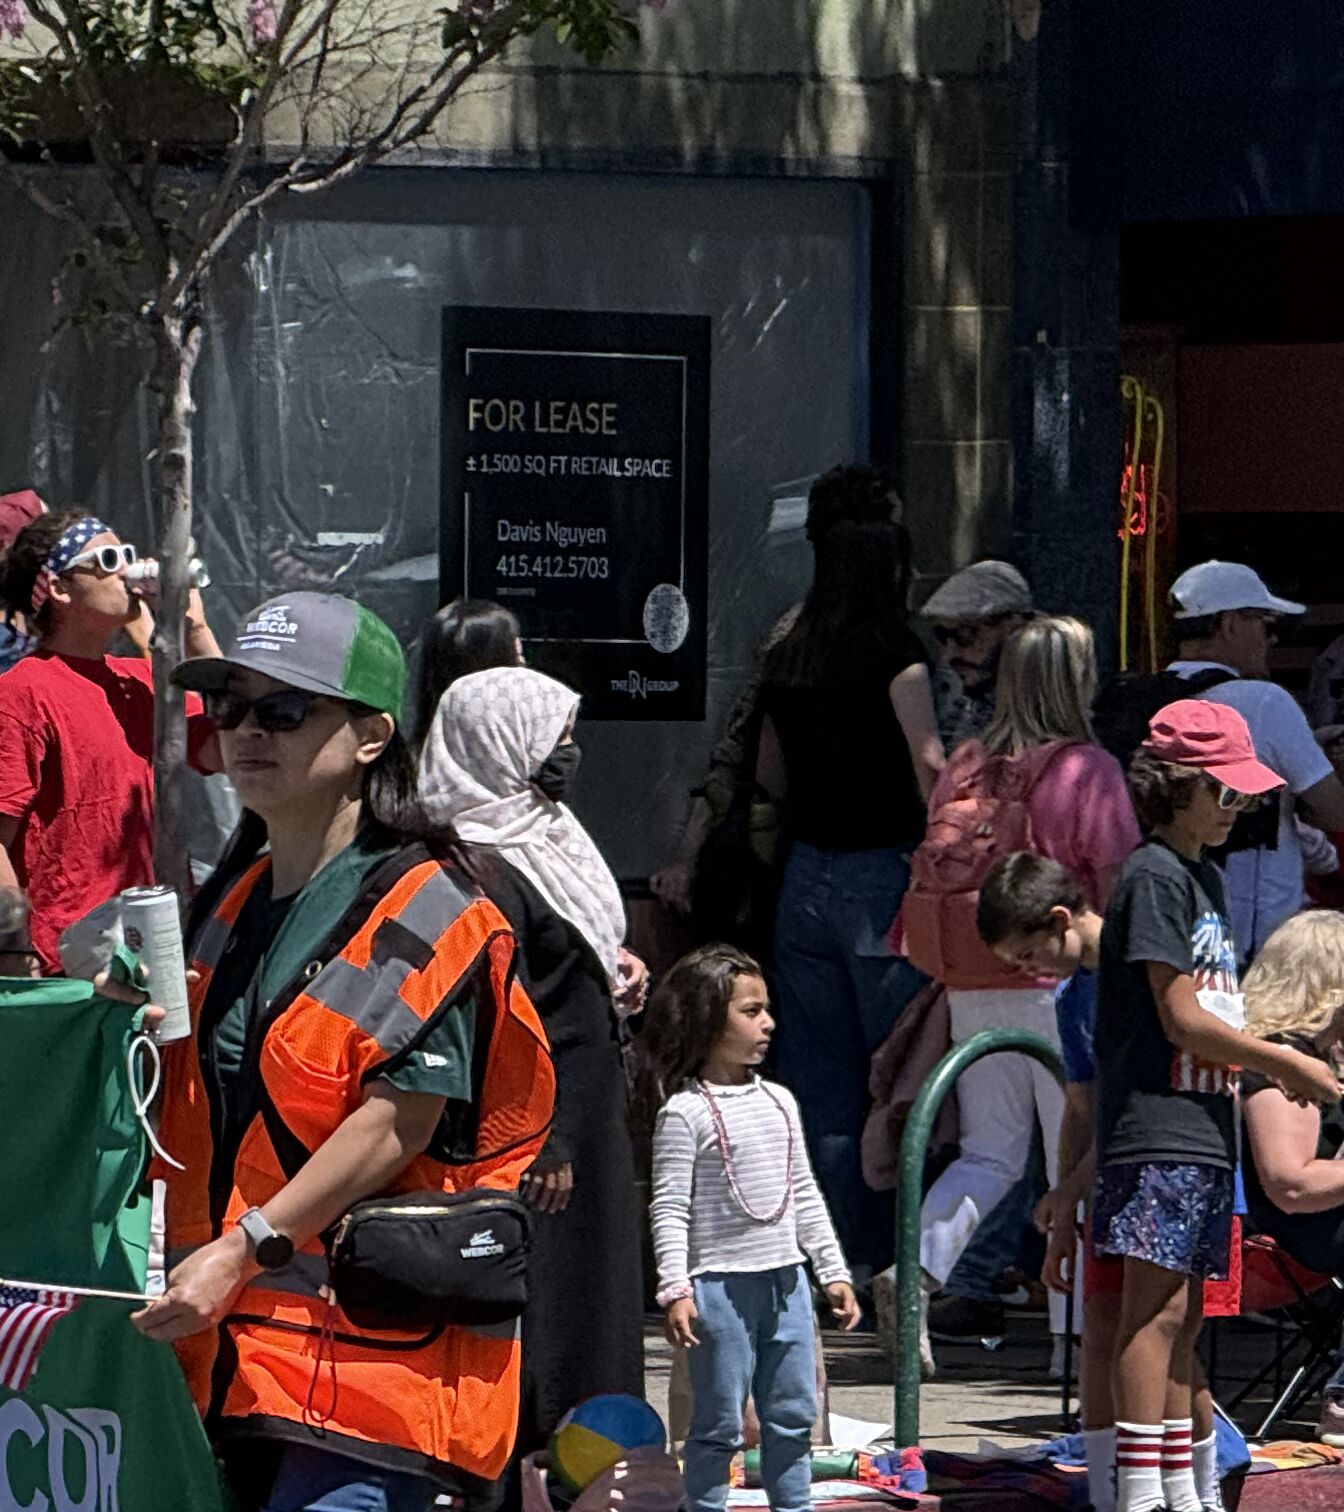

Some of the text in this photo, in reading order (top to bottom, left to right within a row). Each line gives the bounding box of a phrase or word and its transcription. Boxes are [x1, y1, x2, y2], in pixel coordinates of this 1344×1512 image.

[468, 398, 618, 435] FOR LEASE
[523, 455, 546, 477] SQ
[549, 456, 568, 474] FT
[571, 457, 621, 477] RETAIL
[623, 457, 673, 478] SPACE
[497, 519, 607, 548] Davis Nguyen
[496, 554, 609, 579] 415.412.5703
